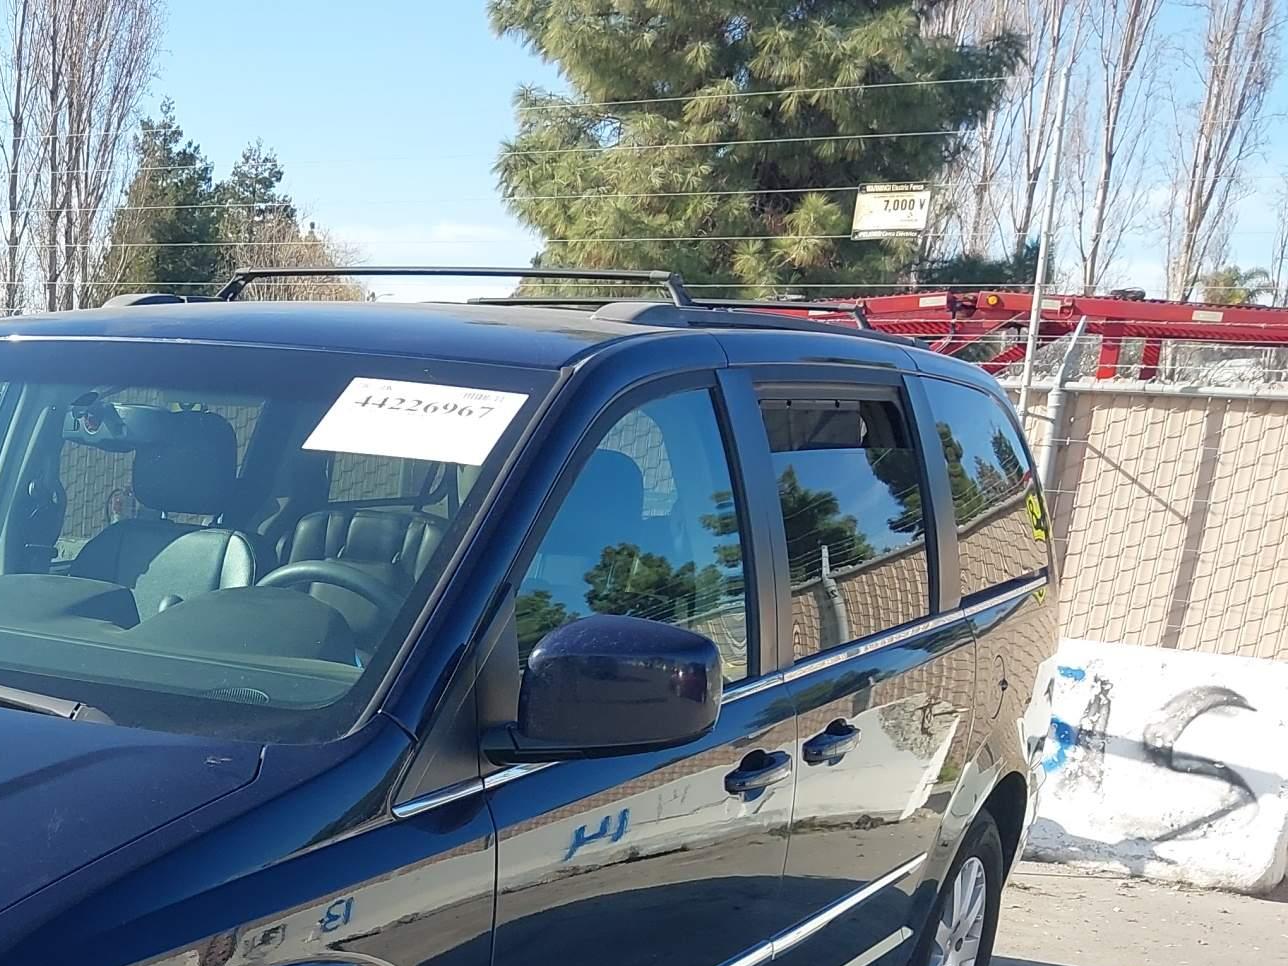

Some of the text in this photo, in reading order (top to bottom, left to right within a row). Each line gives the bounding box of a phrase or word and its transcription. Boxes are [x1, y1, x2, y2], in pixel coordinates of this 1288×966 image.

[884, 199, 926, 213] 7,000 V
[354, 395, 495, 419] 44226967
